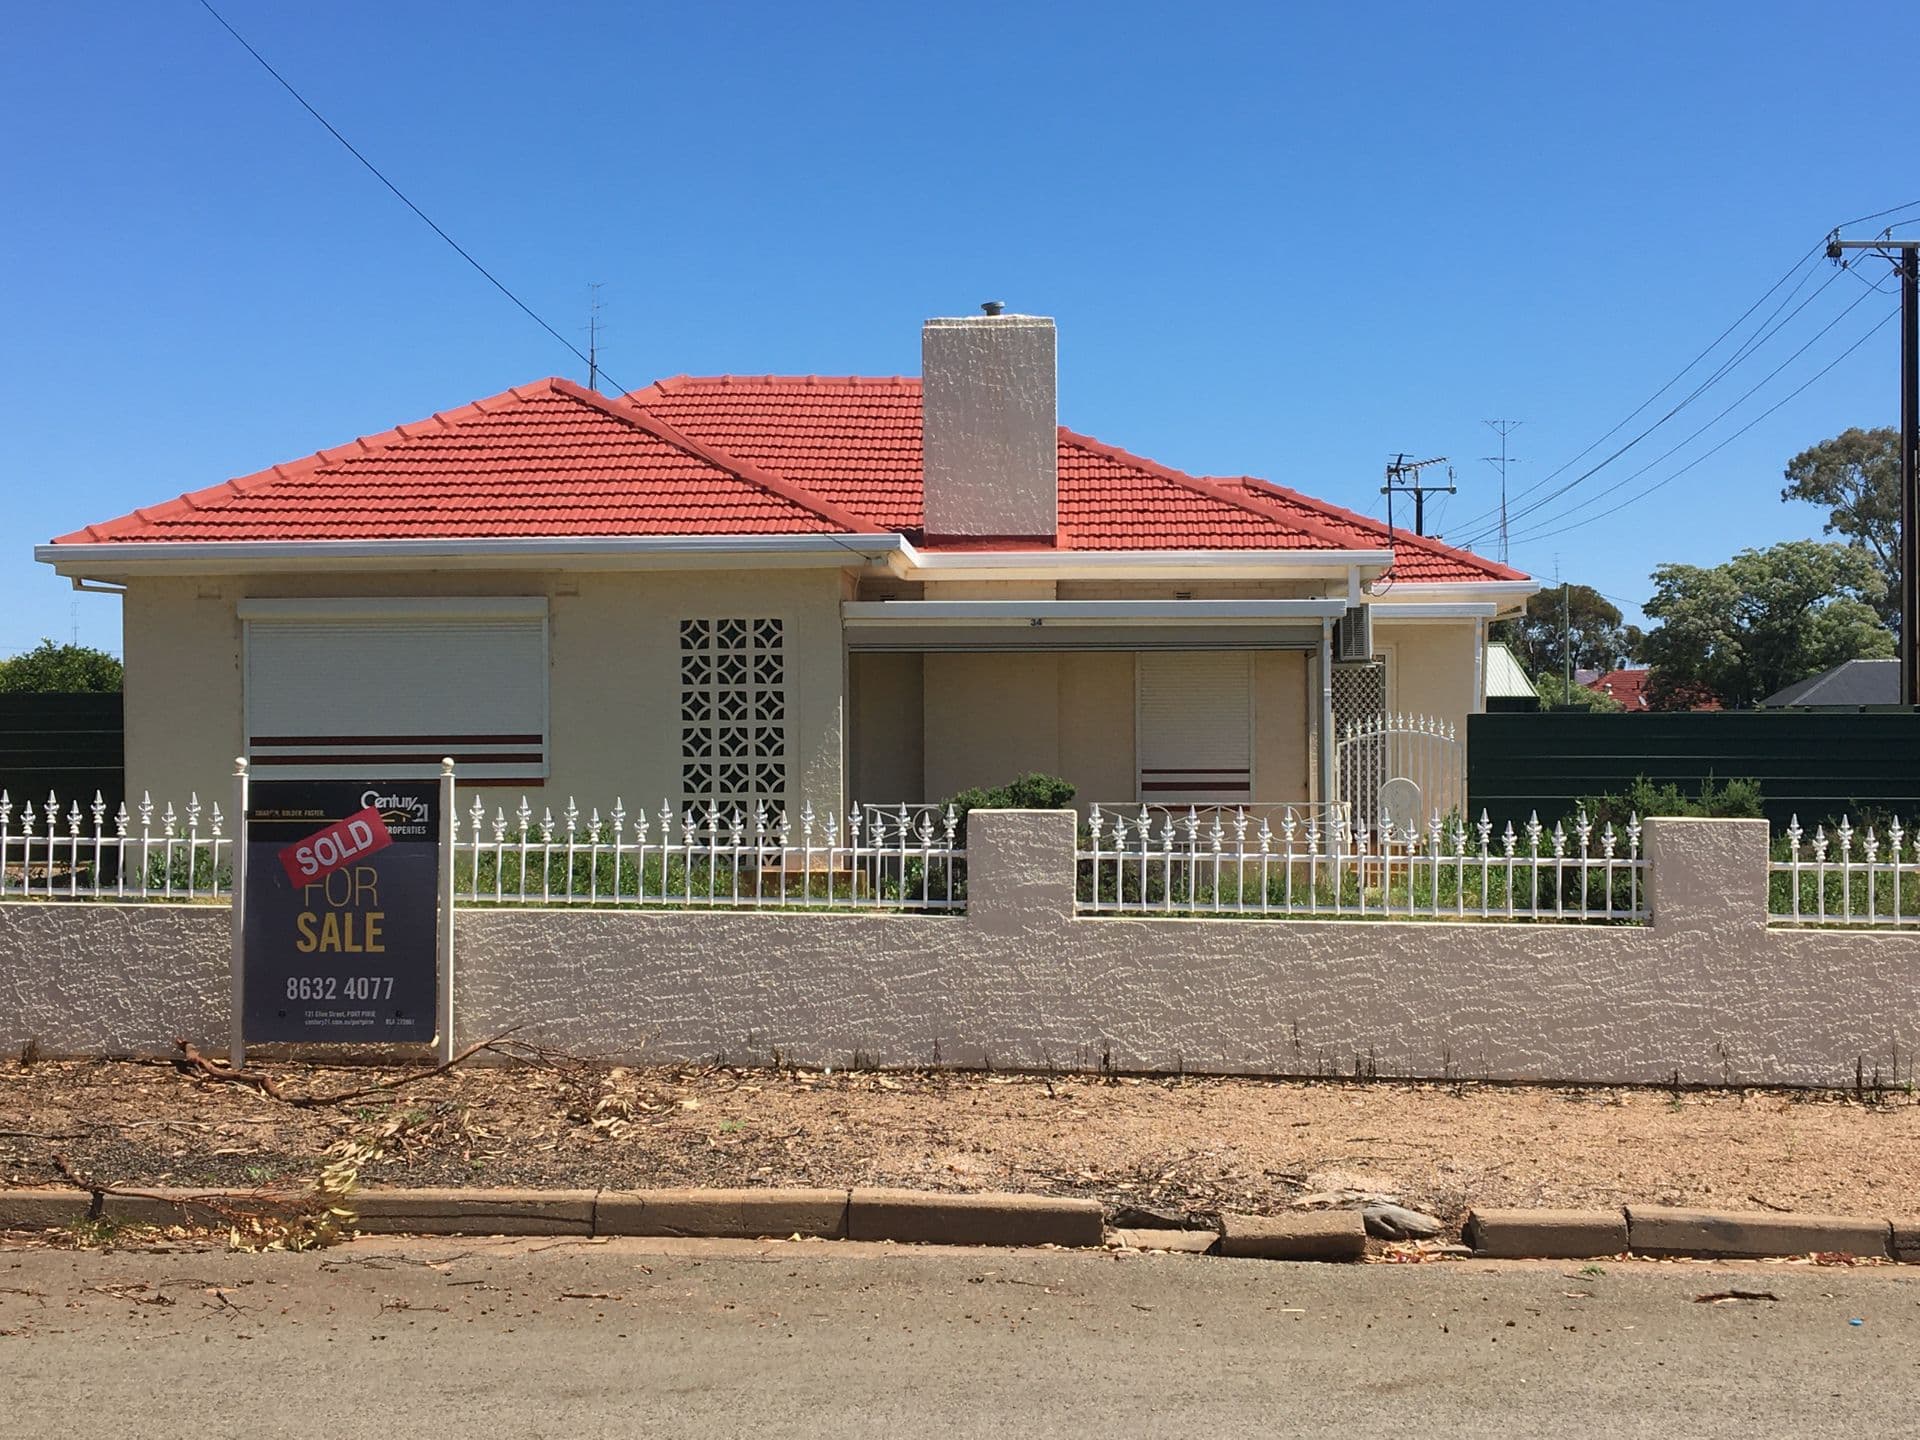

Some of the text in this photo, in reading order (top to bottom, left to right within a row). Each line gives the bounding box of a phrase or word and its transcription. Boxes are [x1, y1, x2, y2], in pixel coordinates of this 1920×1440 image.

[1030, 617, 1042, 626] 34
[361, 790, 429, 822] Century 21
[385, 825, 427, 835] ROPERTIES
[296, 819, 374, 876] SOLD
[296, 911, 386, 953] SALE
[286, 977, 394, 1000] 8632 4077
